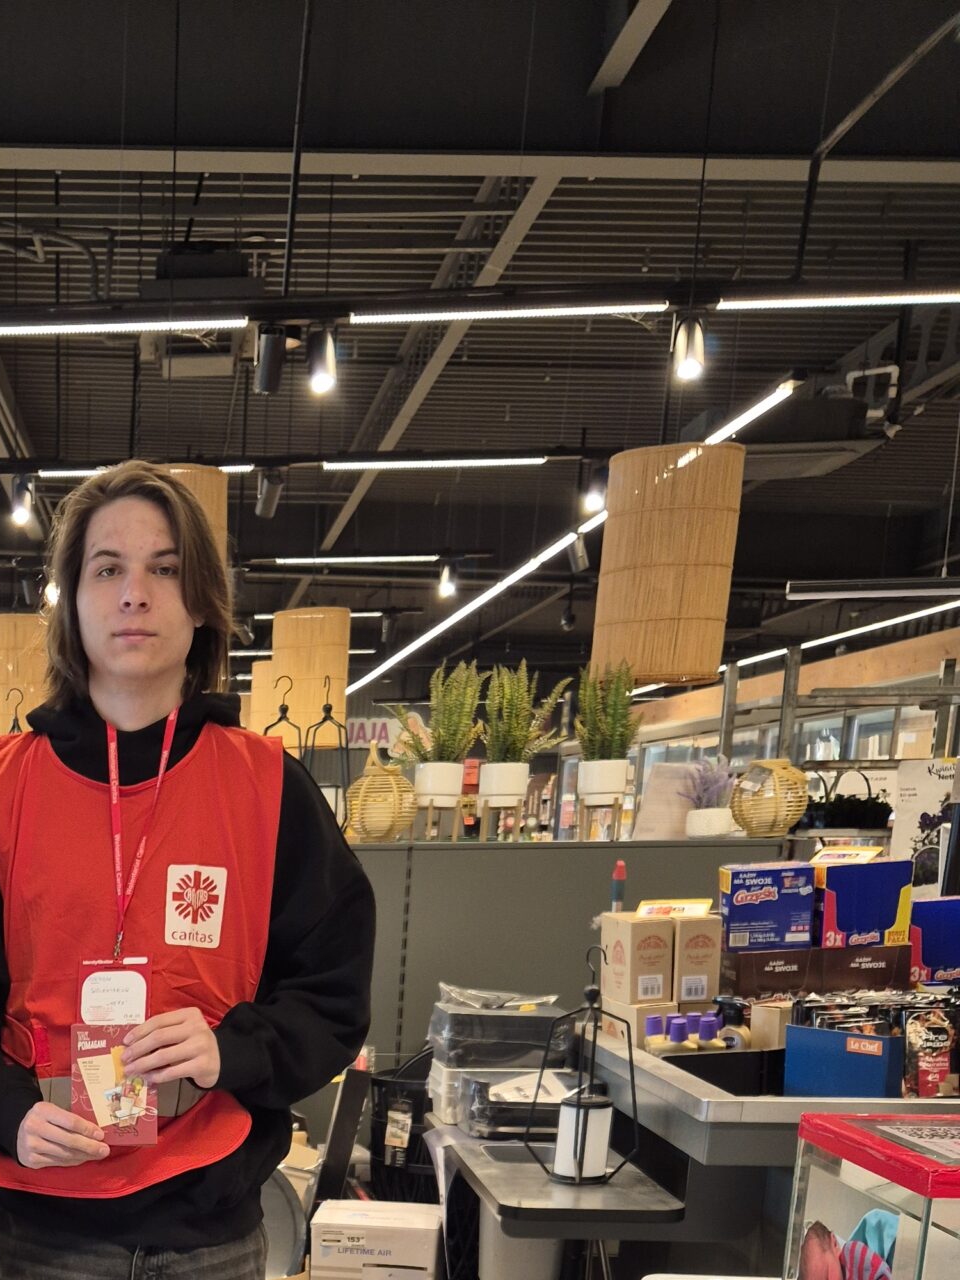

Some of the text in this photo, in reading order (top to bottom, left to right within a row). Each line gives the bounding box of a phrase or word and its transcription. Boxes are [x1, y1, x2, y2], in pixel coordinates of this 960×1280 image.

[745, 877, 773, 886] SWOJE
[171, 929, 214, 943] caritas
[826, 931, 843, 947] 3x
[850, 1041, 879, 1052] Le Chef
[337, 1247, 392, 1257] LIFETIME AIR
